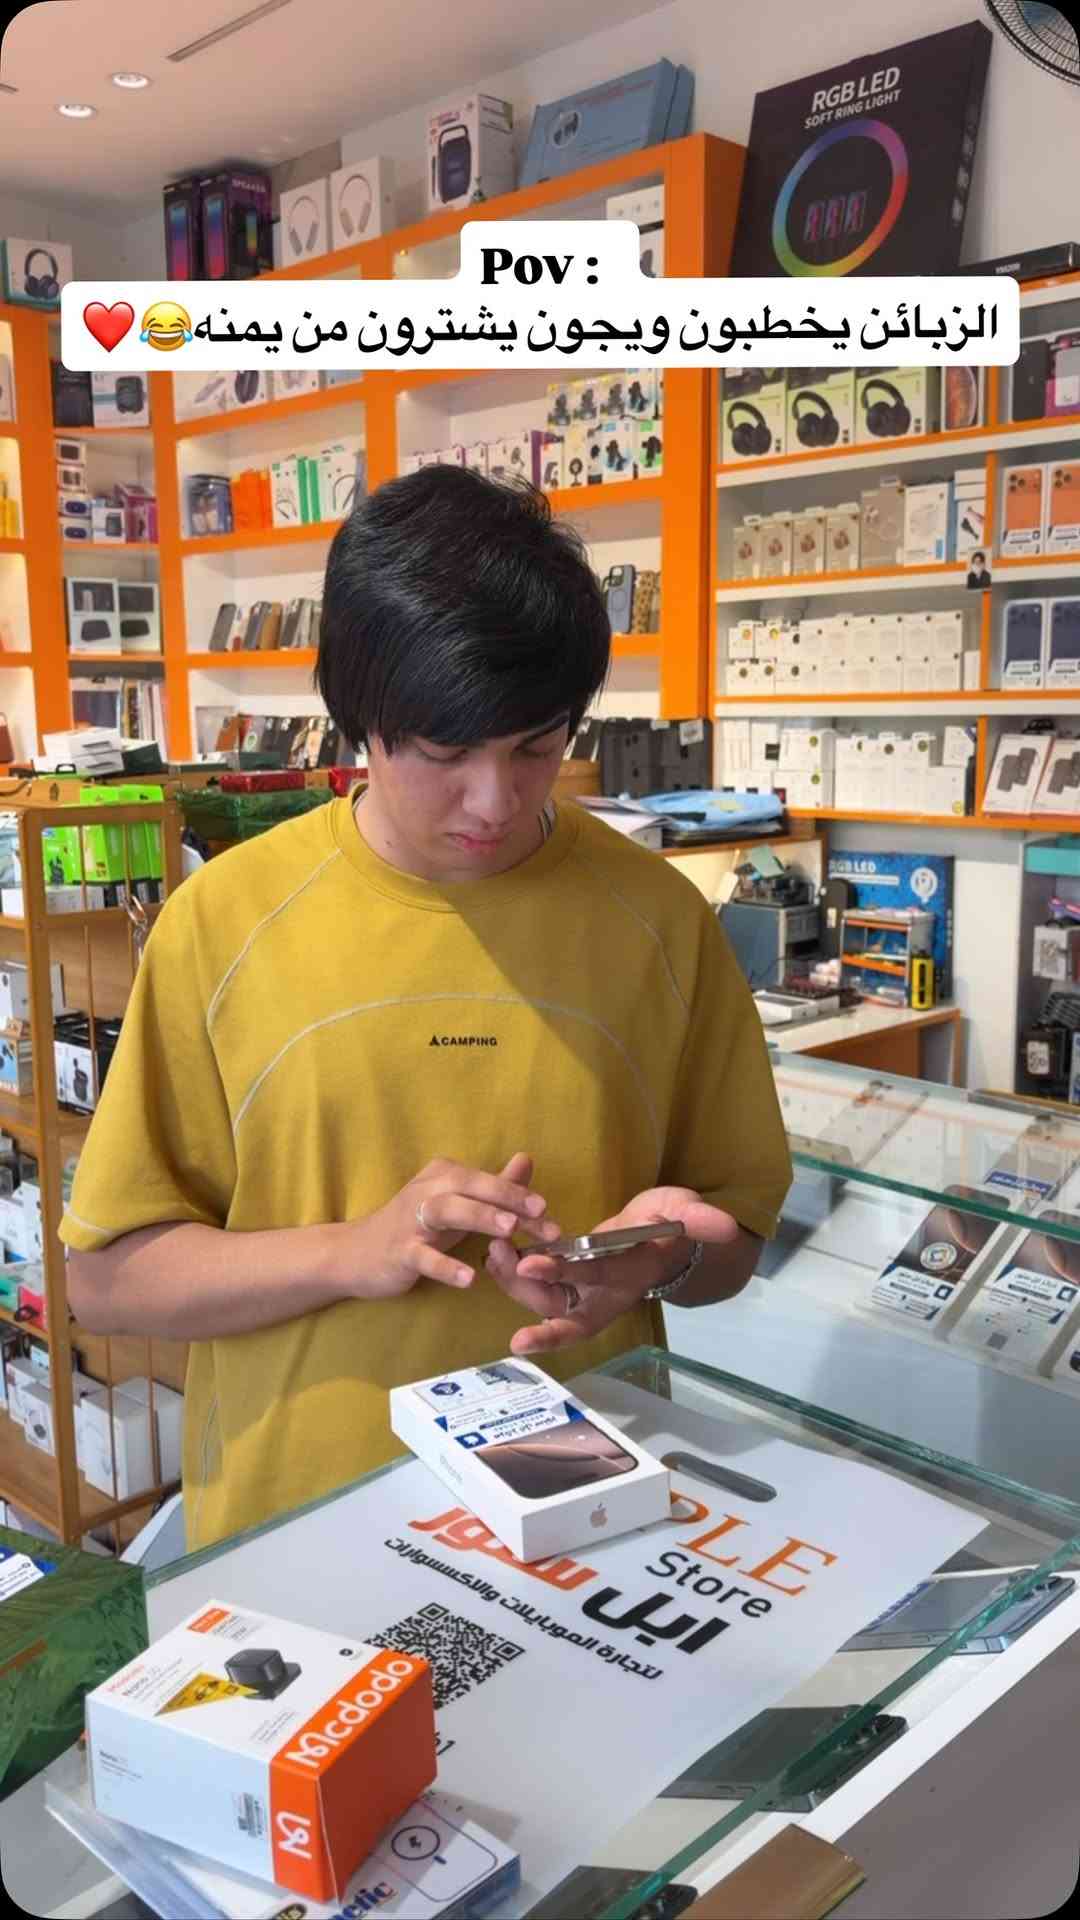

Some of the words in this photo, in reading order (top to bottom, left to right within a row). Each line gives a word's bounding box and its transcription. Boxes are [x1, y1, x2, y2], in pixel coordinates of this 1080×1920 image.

[804, 110, 833, 129] SOFT
[835, 102, 863, 120] RING
[865, 89, 902, 111] LIGHT
[811, 80, 856, 113] RGB
[858, 66, 900, 98] LED
[384, 1538, 501, 1602] والاكسسوارات
[644, 1551, 772, 1618] Store
[499, 1597, 600, 1651] الموبايلات
[581, 1586, 731, 1655] ابل
[595, 1642, 664, 1680] لتجارة
